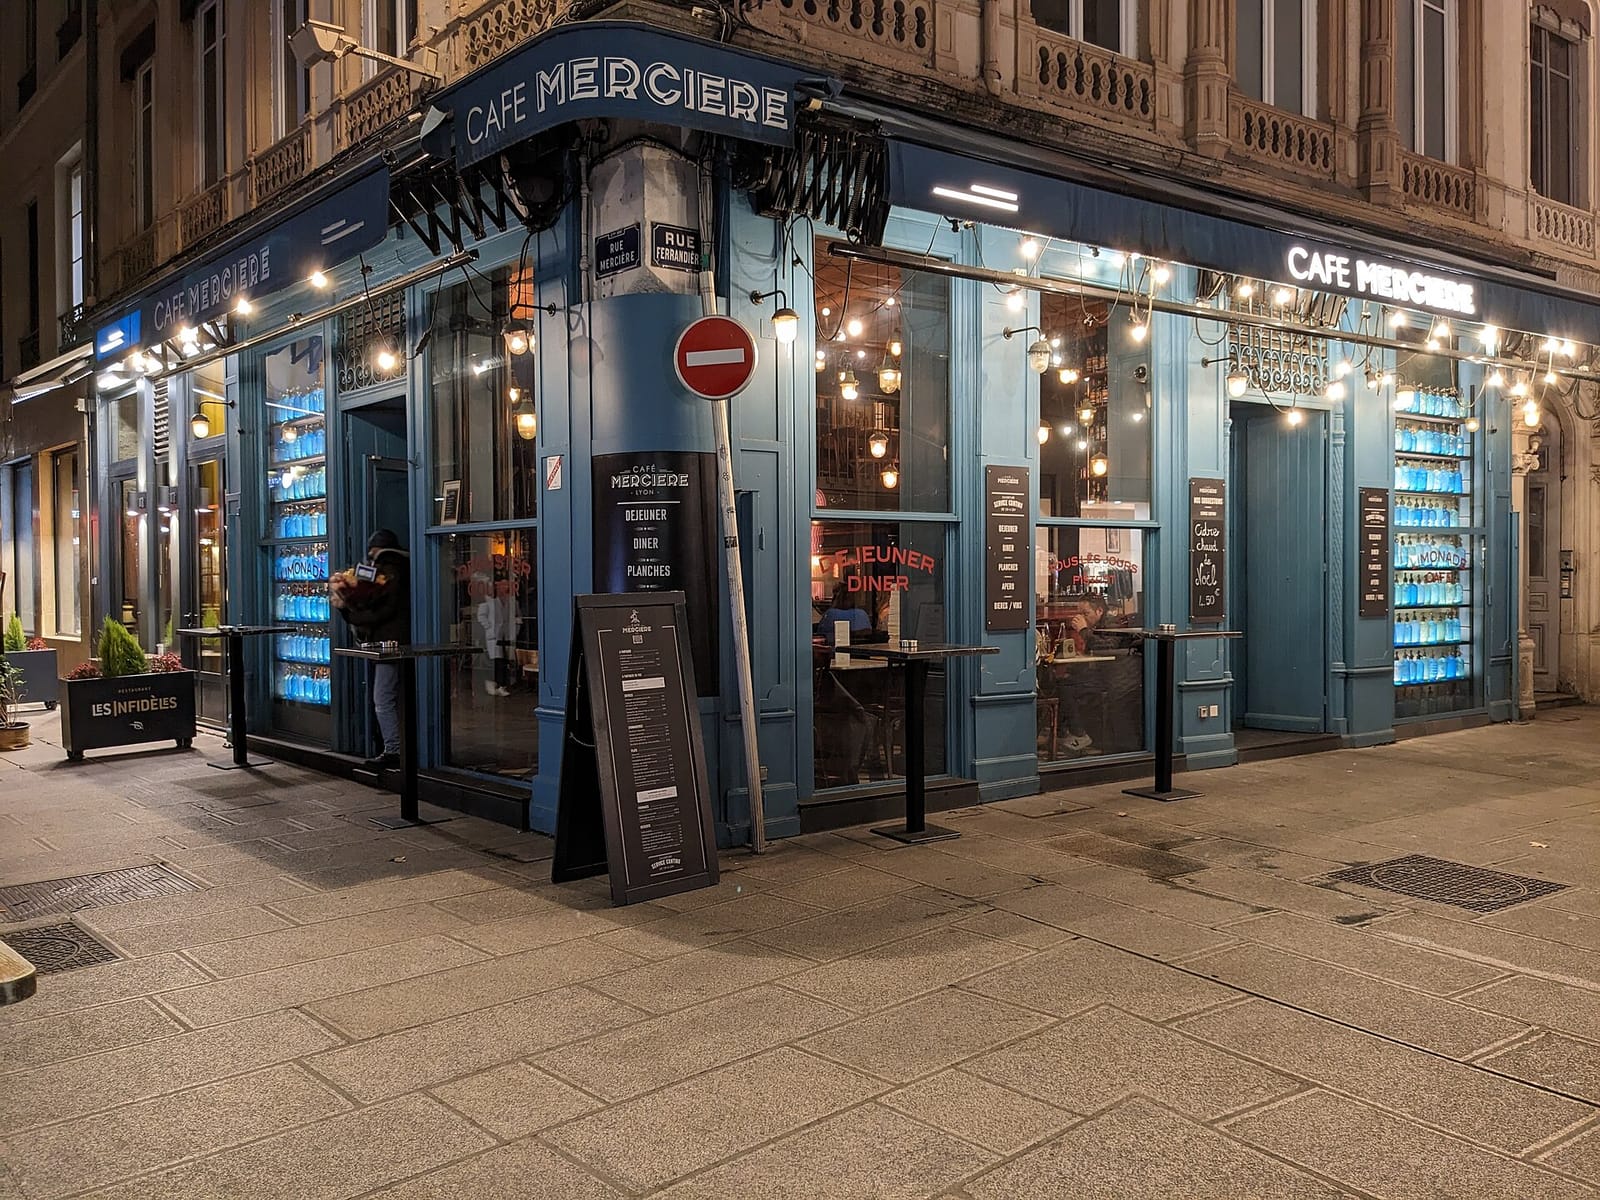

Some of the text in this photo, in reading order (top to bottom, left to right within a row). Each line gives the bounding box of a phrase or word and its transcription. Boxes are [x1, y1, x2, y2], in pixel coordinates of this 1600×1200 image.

[466, 56, 788, 145] CAFE MERCIERE
[609, 240, 624, 253] RUE
[665, 231, 695, 249] RUE
[600, 251, 635, 271] MERCIÈRE
[154, 246, 270, 331] CAFE MERCIERE
[1288, 246, 1476, 315] CAFE MERCIERE
[632, 463, 656, 473] CAFÉ
[610, 473, 689, 489] MERCIERE
[625, 509, 667, 521] DEJEUNER
[1194, 521, 1220, 537] Cidre
[633, 537, 659, 549] DINER
[627, 565, 671, 577] PLANCHES
[847, 575, 909, 592] DINER
[92, 695, 178, 717] LES INFIDÈLES
